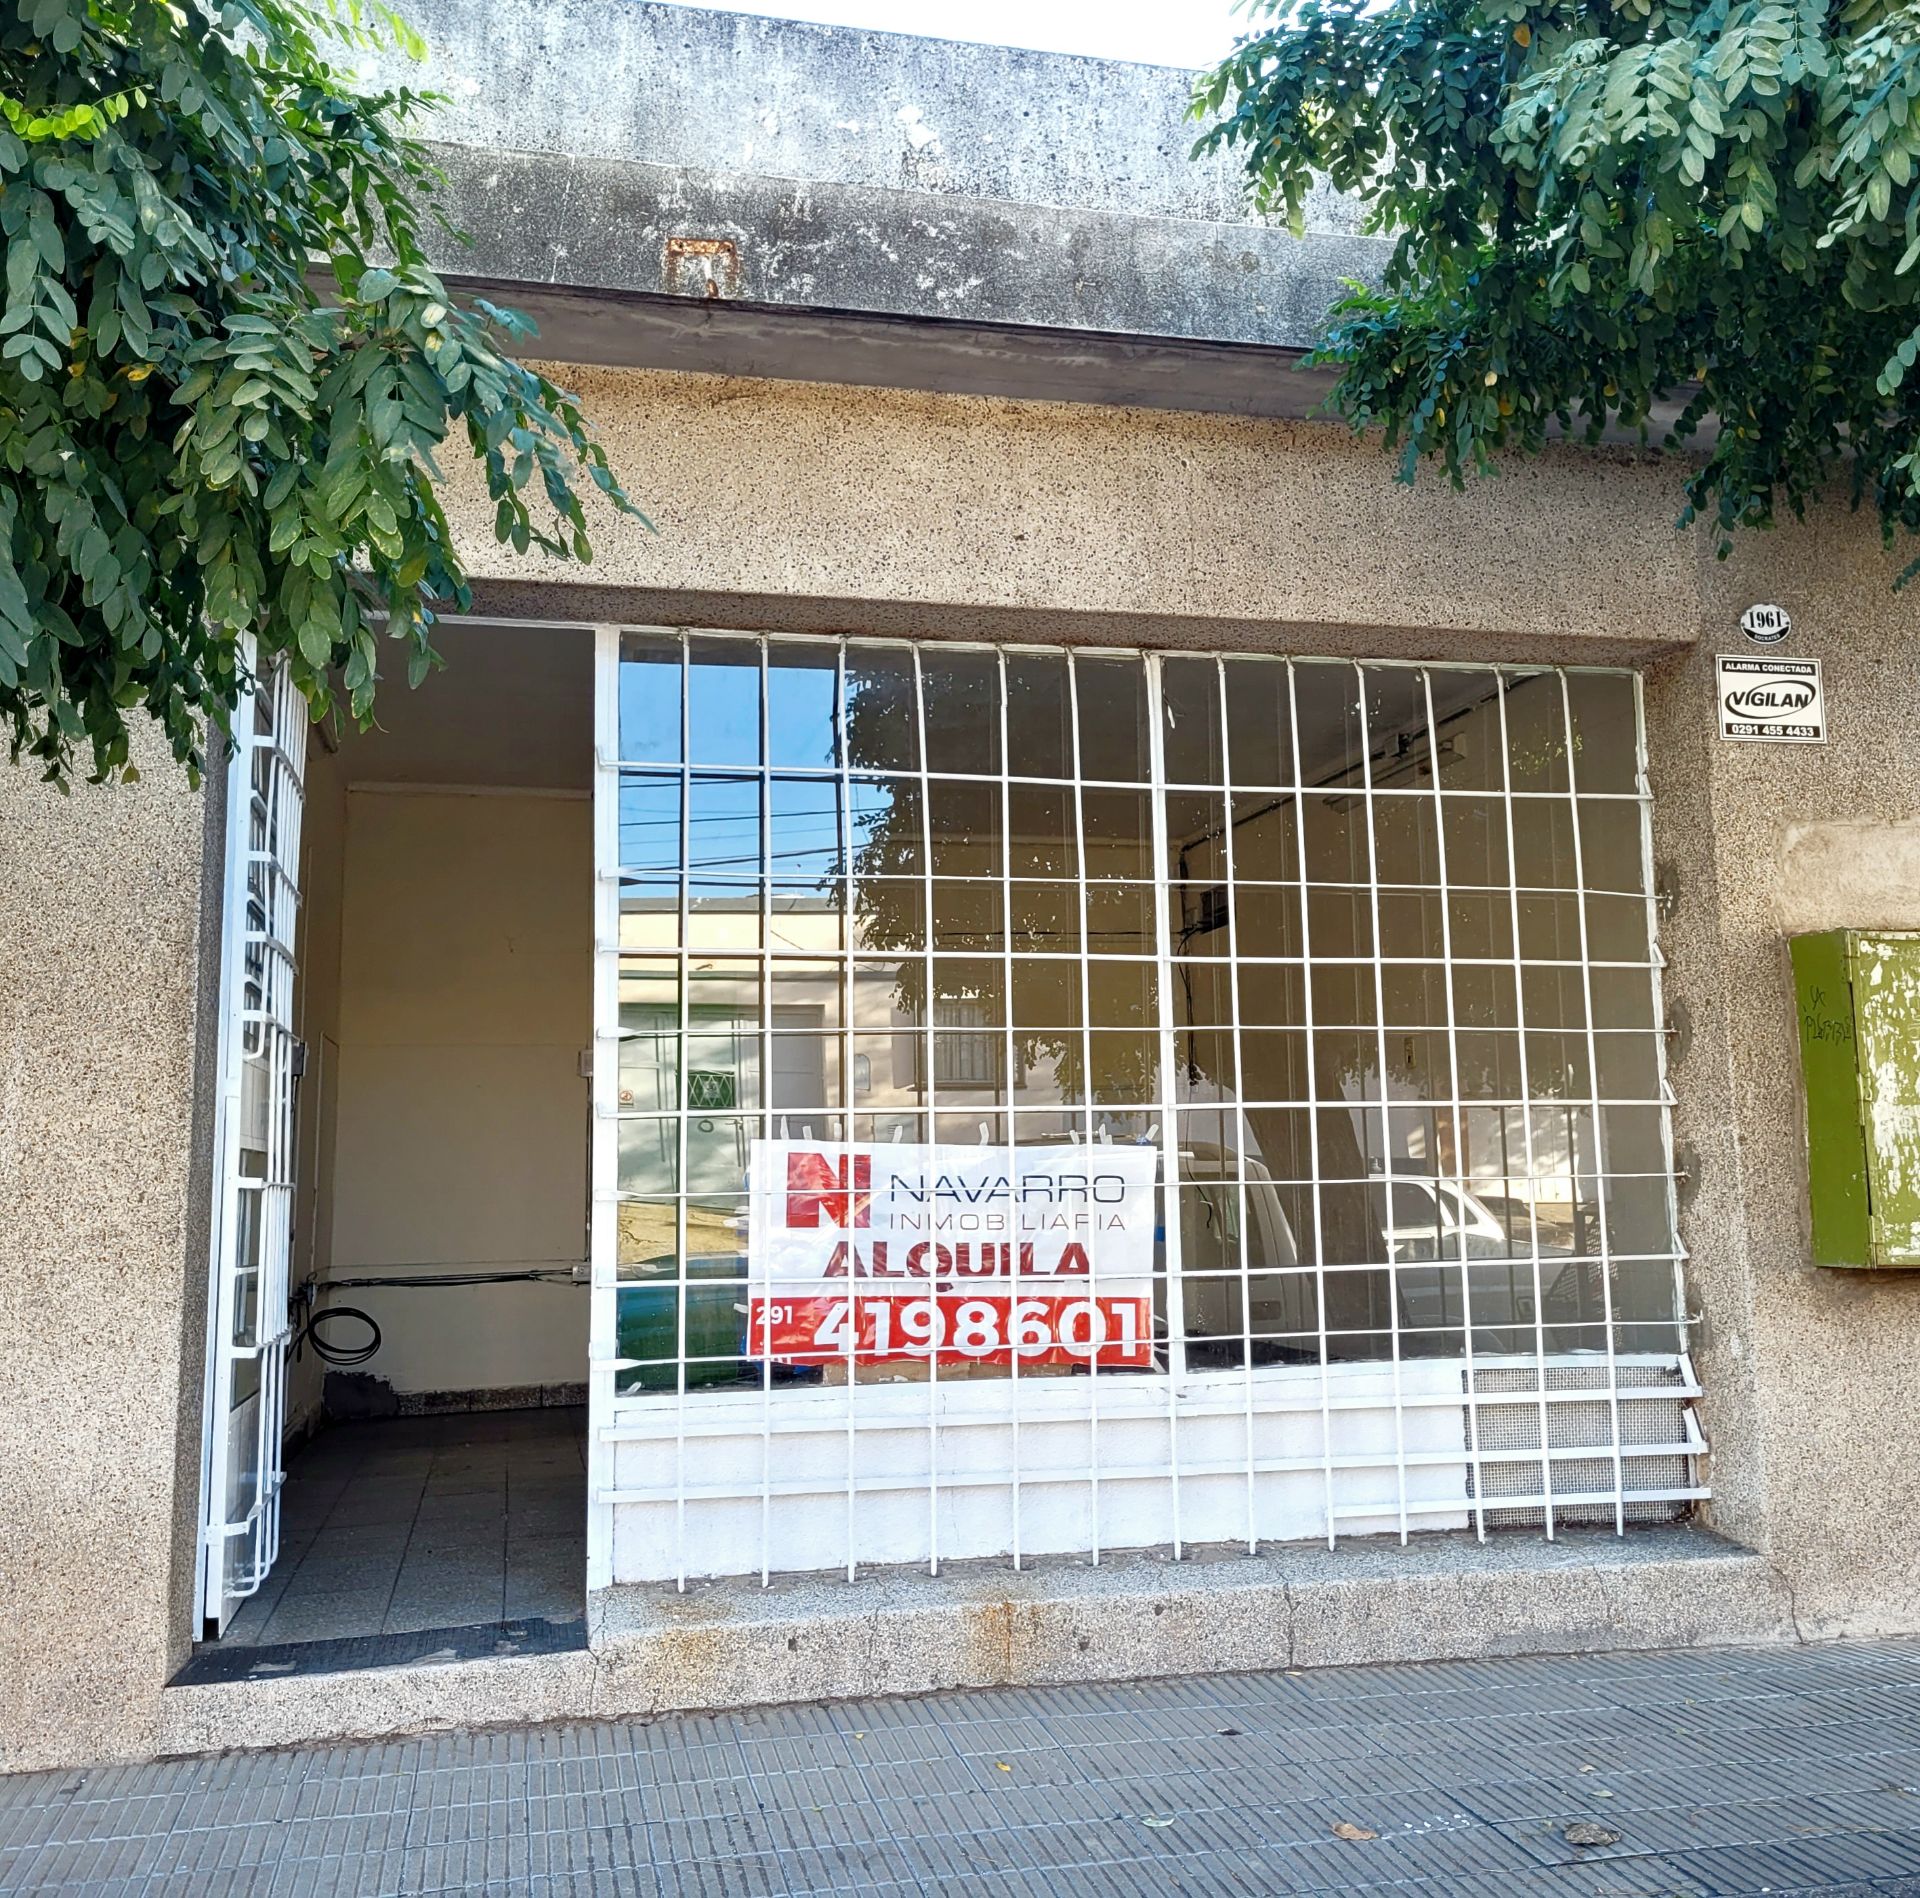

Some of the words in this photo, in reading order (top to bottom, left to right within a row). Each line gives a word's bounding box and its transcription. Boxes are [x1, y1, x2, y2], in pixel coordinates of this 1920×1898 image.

[1749, 611, 1782, 628] 1961
[1725, 662, 1760, 671] ALARMA
[1762, 664, 1812, 673] CONECTADA
[1732, 691, 1809, 709] VIGILAN
[1731, 724, 1758, 734] 0291
[1762, 725, 1783, 735] 455
[1786, 726, 1814, 736] 4433
[890, 1174, 1125, 1203] NAVARRO
[823, 1240, 1095, 1292] ALQUILA
[755, 1305, 793, 1325] 291
[814, 1300, 1137, 1359] 4198601
